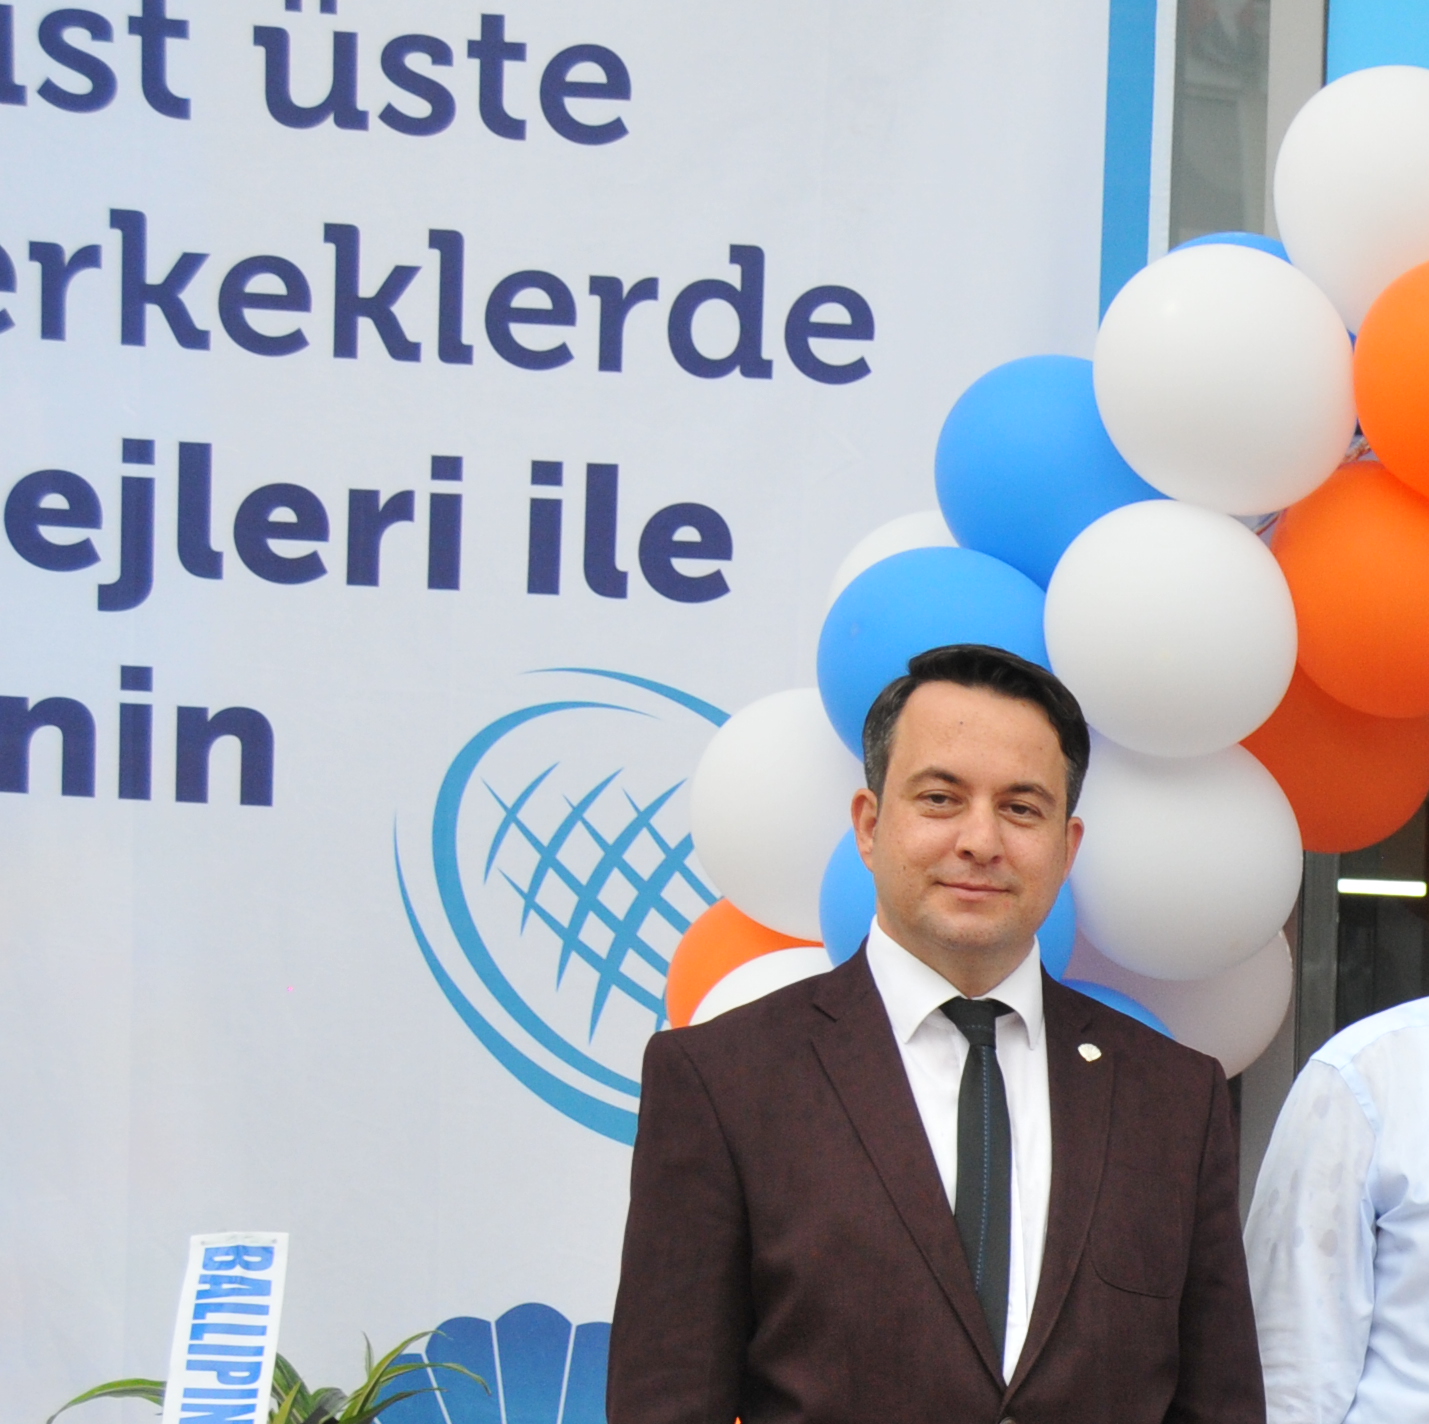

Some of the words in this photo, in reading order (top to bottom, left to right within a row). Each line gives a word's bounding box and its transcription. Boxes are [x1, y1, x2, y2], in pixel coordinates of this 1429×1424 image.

[0, 0, 191, 120] st
[253, 0, 632, 146] üste
[0, 208, 876, 385] rkeklerde
[4, 438, 463, 612] ejleri
[527, 460, 733, 604] ile
[0, 665, 275, 807] nin
